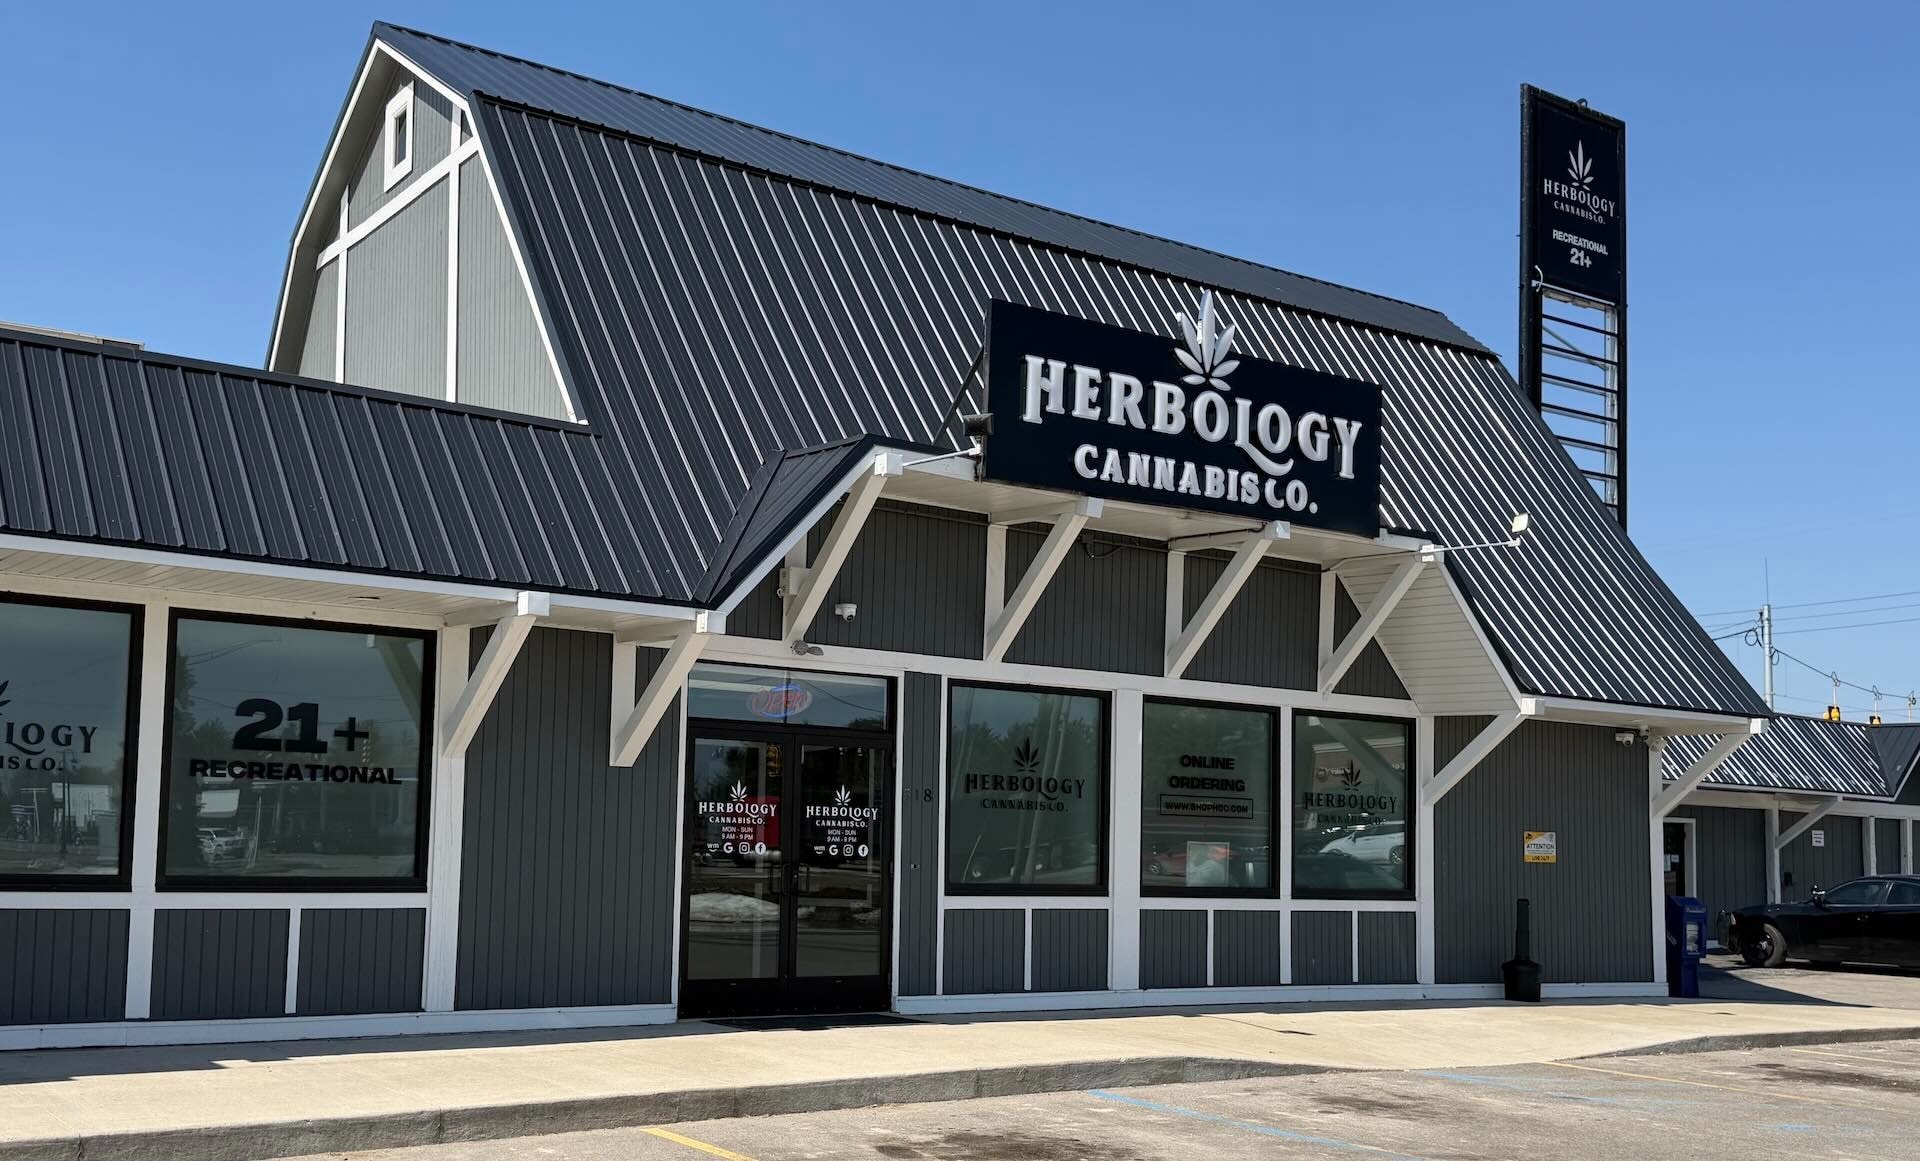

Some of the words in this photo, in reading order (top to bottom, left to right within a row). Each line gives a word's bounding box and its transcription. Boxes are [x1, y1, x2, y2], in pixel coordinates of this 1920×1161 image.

[1543, 178, 1616, 217] HERBOLOGY
[1552, 228, 1609, 255] RECREATIONAL
[1570, 248, 1592, 268] 21+
[1021, 353, 1364, 480] HERBOLOGY
[1072, 442, 1261, 506] CANNABIS
[231, 697, 370, 755] 21+
[189, 758, 403, 785] RECREATIONAL
[1180, 754, 1235, 770] ONLINE
[965, 773, 1085, 800] HERBOLOGY
[1168, 775, 1246, 792] ORDERING
[698, 801, 777, 818] HERBOLOGY
[805, 805, 878, 821] HERBOLOGY
[1303, 792, 1397, 815] HERBOLOGY
